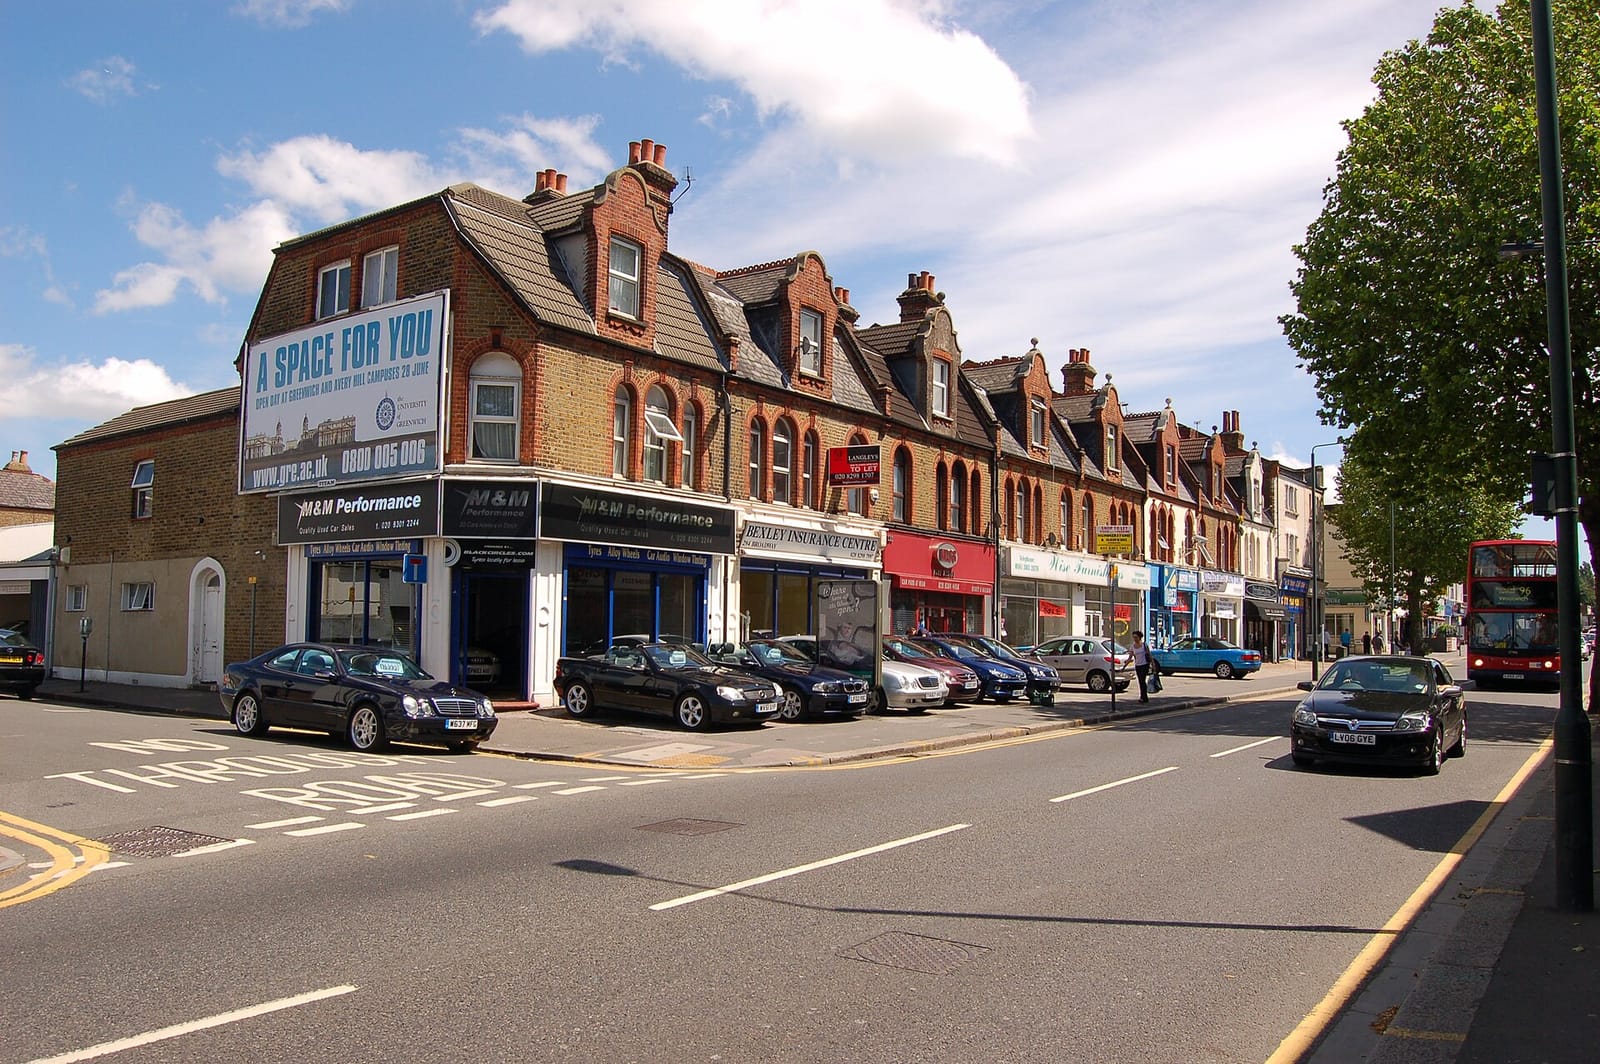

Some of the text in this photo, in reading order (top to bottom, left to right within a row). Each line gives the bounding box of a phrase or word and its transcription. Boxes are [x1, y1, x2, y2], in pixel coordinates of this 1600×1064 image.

[257, 310, 432, 393] A SPACE FOR YOU
[256, 397, 268, 410] OPEN
[270, 394, 280, 407] DAY
[281, 391, 288, 404] AT
[289, 383, 319, 402] GREENWICH
[321, 380, 332, 395] AND
[334, 375, 351, 391] AVERY
[353, 372, 365, 387] HILL
[367, 366, 400, 384] CAMPUSES
[412, 361, 429, 377] JUNE
[397, 400, 427, 410] UNIVERSITY
[397, 418, 427, 428] GREENWICH
[253, 439, 425, 488] www.gre.ac.uk 0800 005 006
[301, 495, 421, 517] M&M Performance
[469, 489, 529, 507] M&M
[466, 508, 525, 517] Performance
[582, 496, 713, 527] M&M Performance
[300, 526, 316, 535] Quality
[317, 525, 329, 533] Used
[330, 524, 339, 532] Car
[341, 523, 355, 532] Sales
[381, 521, 391, 529] 020
[580, 525, 602, 535] Quality
[604, 526, 618, 535] Used
[620, 528, 631, 536] Car
[746, 524, 878, 552] BEXLEY INSURANCE CENTRE
[310, 545, 321, 557] Tyres
[323, 543, 334, 555] Alloy
[335, 543, 351, 553] Wheels
[352, 543, 360, 553] Car
[360, 543, 374, 553] Audio
[376, 541, 394, 552] Window
[588, 545, 602, 558] Tyres
[608, 547, 620, 560] Alloy
[622, 549, 640, 559] Wheels
[647, 550, 656, 560] Car
[656, 551, 670, 562] Audio
[673, 554, 691, 563] Window
[1519, 586, 1532, 596] 96
[87, 738, 230, 755] NO
[1357, 734, 1374, 743] GYE
[44, 751, 456, 793] THROUGH
[240, 771, 507, 810] ROAD
